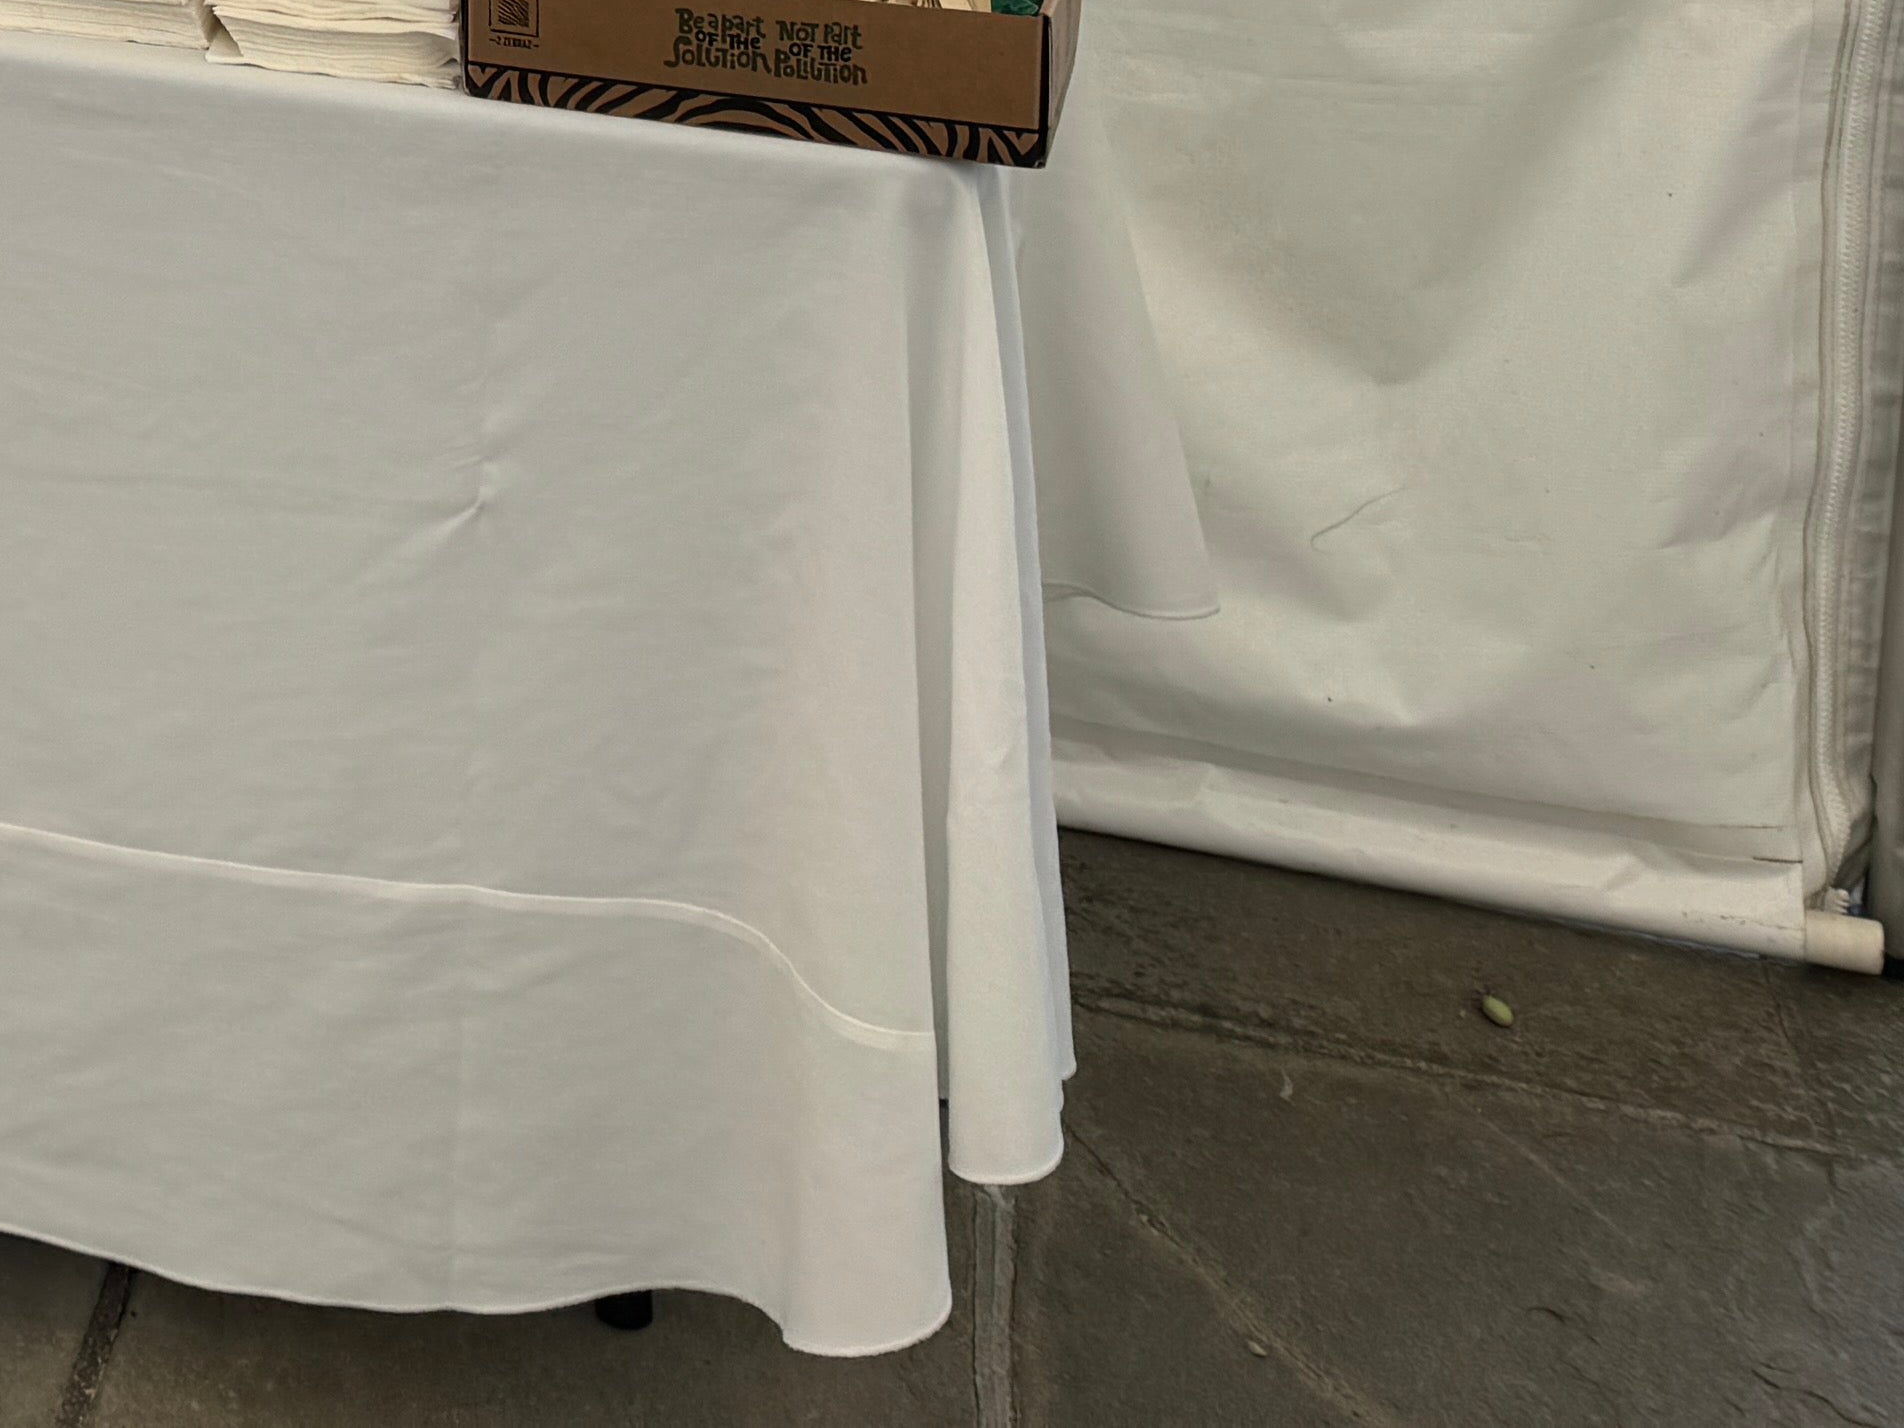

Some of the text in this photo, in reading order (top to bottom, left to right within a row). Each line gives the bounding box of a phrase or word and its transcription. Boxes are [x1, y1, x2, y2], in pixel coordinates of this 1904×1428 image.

[675, 8, 766, 44] Be a part
[695, 30, 719, 47] OF
[789, 42, 813, 59] OF
